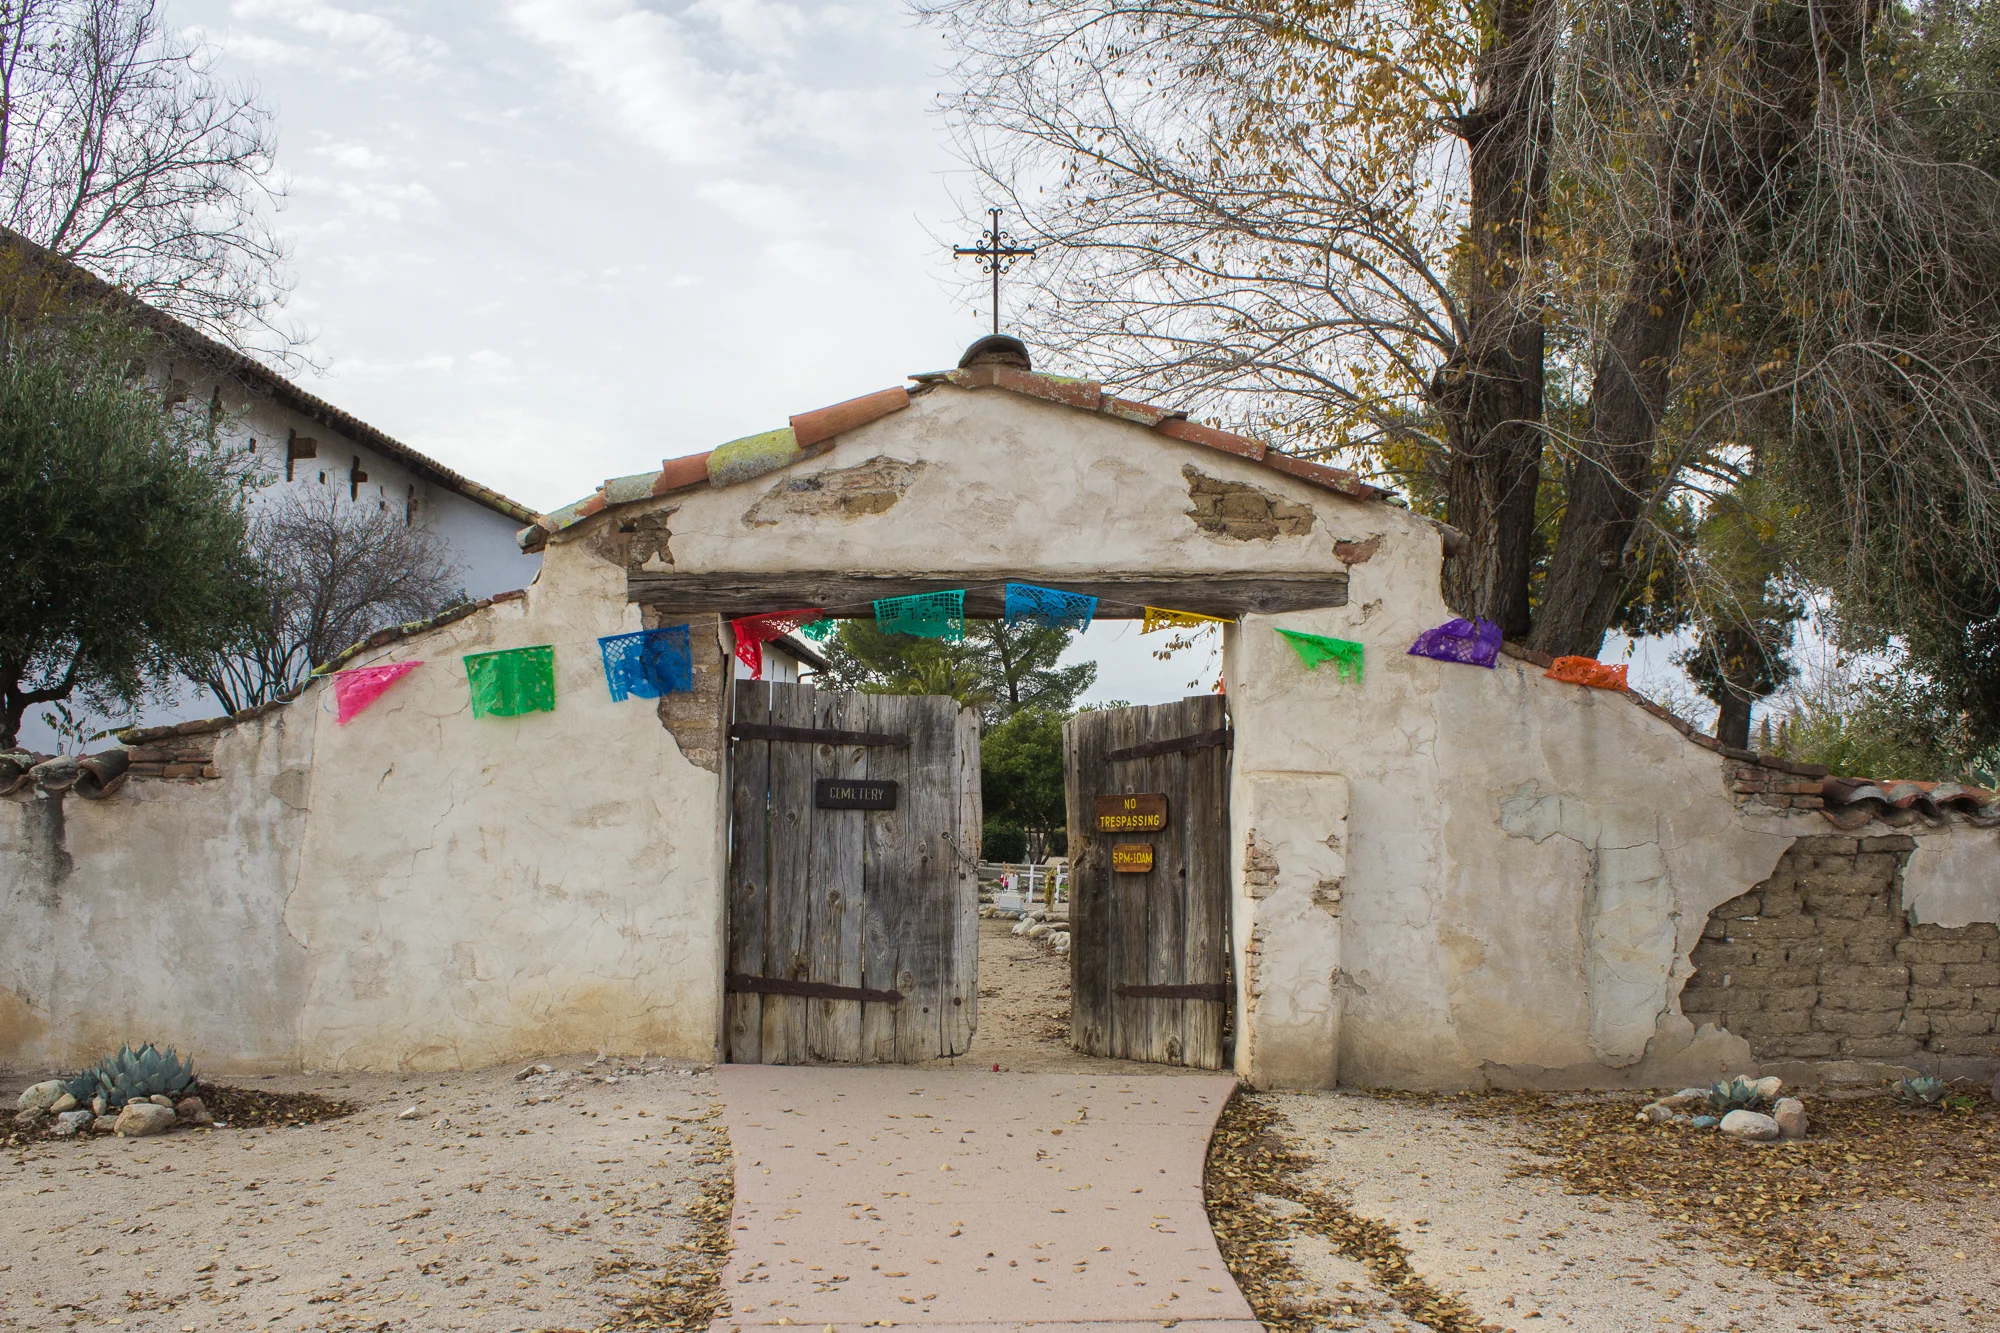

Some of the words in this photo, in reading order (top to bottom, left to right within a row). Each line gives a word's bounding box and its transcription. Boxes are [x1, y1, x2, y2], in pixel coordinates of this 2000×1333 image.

[829, 786, 884, 801] CEMETERY
[1124, 798, 1137, 809] NO
[1100, 814, 1160, 828] TRESPASSING
[1113, 852, 1153, 864] 5PM-10AM
